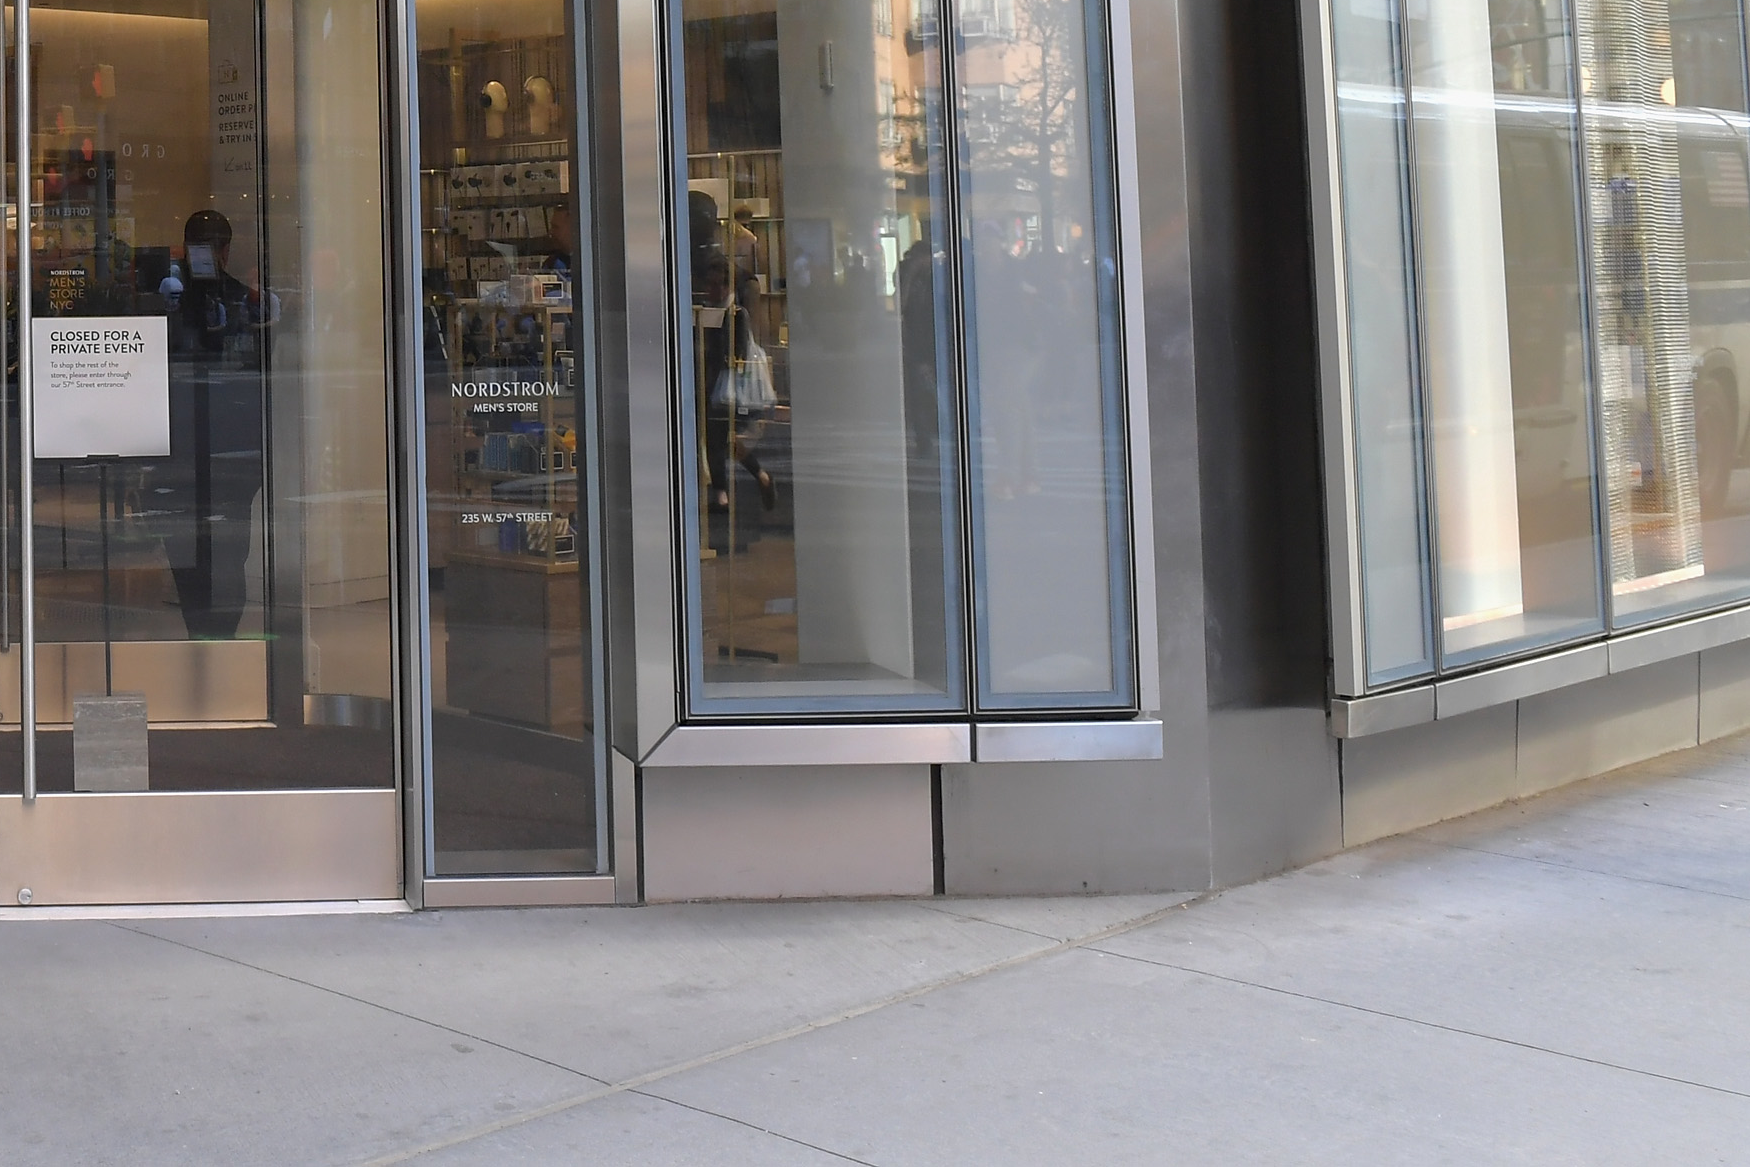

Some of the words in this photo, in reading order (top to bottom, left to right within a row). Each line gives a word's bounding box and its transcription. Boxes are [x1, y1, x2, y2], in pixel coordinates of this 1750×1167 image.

[217, 91, 249, 104] ONLINE
[218, 104, 247, 116] ORDER
[218, 119, 254, 132] RESERVE
[219, 135, 225, 145] &
[226, 134, 241, 144] TRY
[242, 133, 252, 143] IN
[49, 277, 86, 287] MEN'S
[49, 288, 85, 299] STORE
[50, 300, 75, 310] NYC
[50, 331, 100, 342] CLOSED
[103, 330, 129, 341] FOR
[132, 330, 142, 341] A
[51, 343, 101, 354] PRIVATE
[104, 342, 145, 353] EVENT
[59, 361, 74, 370] shop
[75, 360, 86, 368] the
[100, 360, 107, 368] of
[108, 360, 119, 368] the
[69, 371, 88, 380] please
[107, 371, 132, 380] through
[450, 381, 560, 398] NORDSTROM
[473, 402, 505, 413] MEN'S
[506, 402, 539, 412] STORE
[461, 513, 480, 524] 235
[481, 513, 494, 523] W.
[515, 512, 553, 522] STREET
